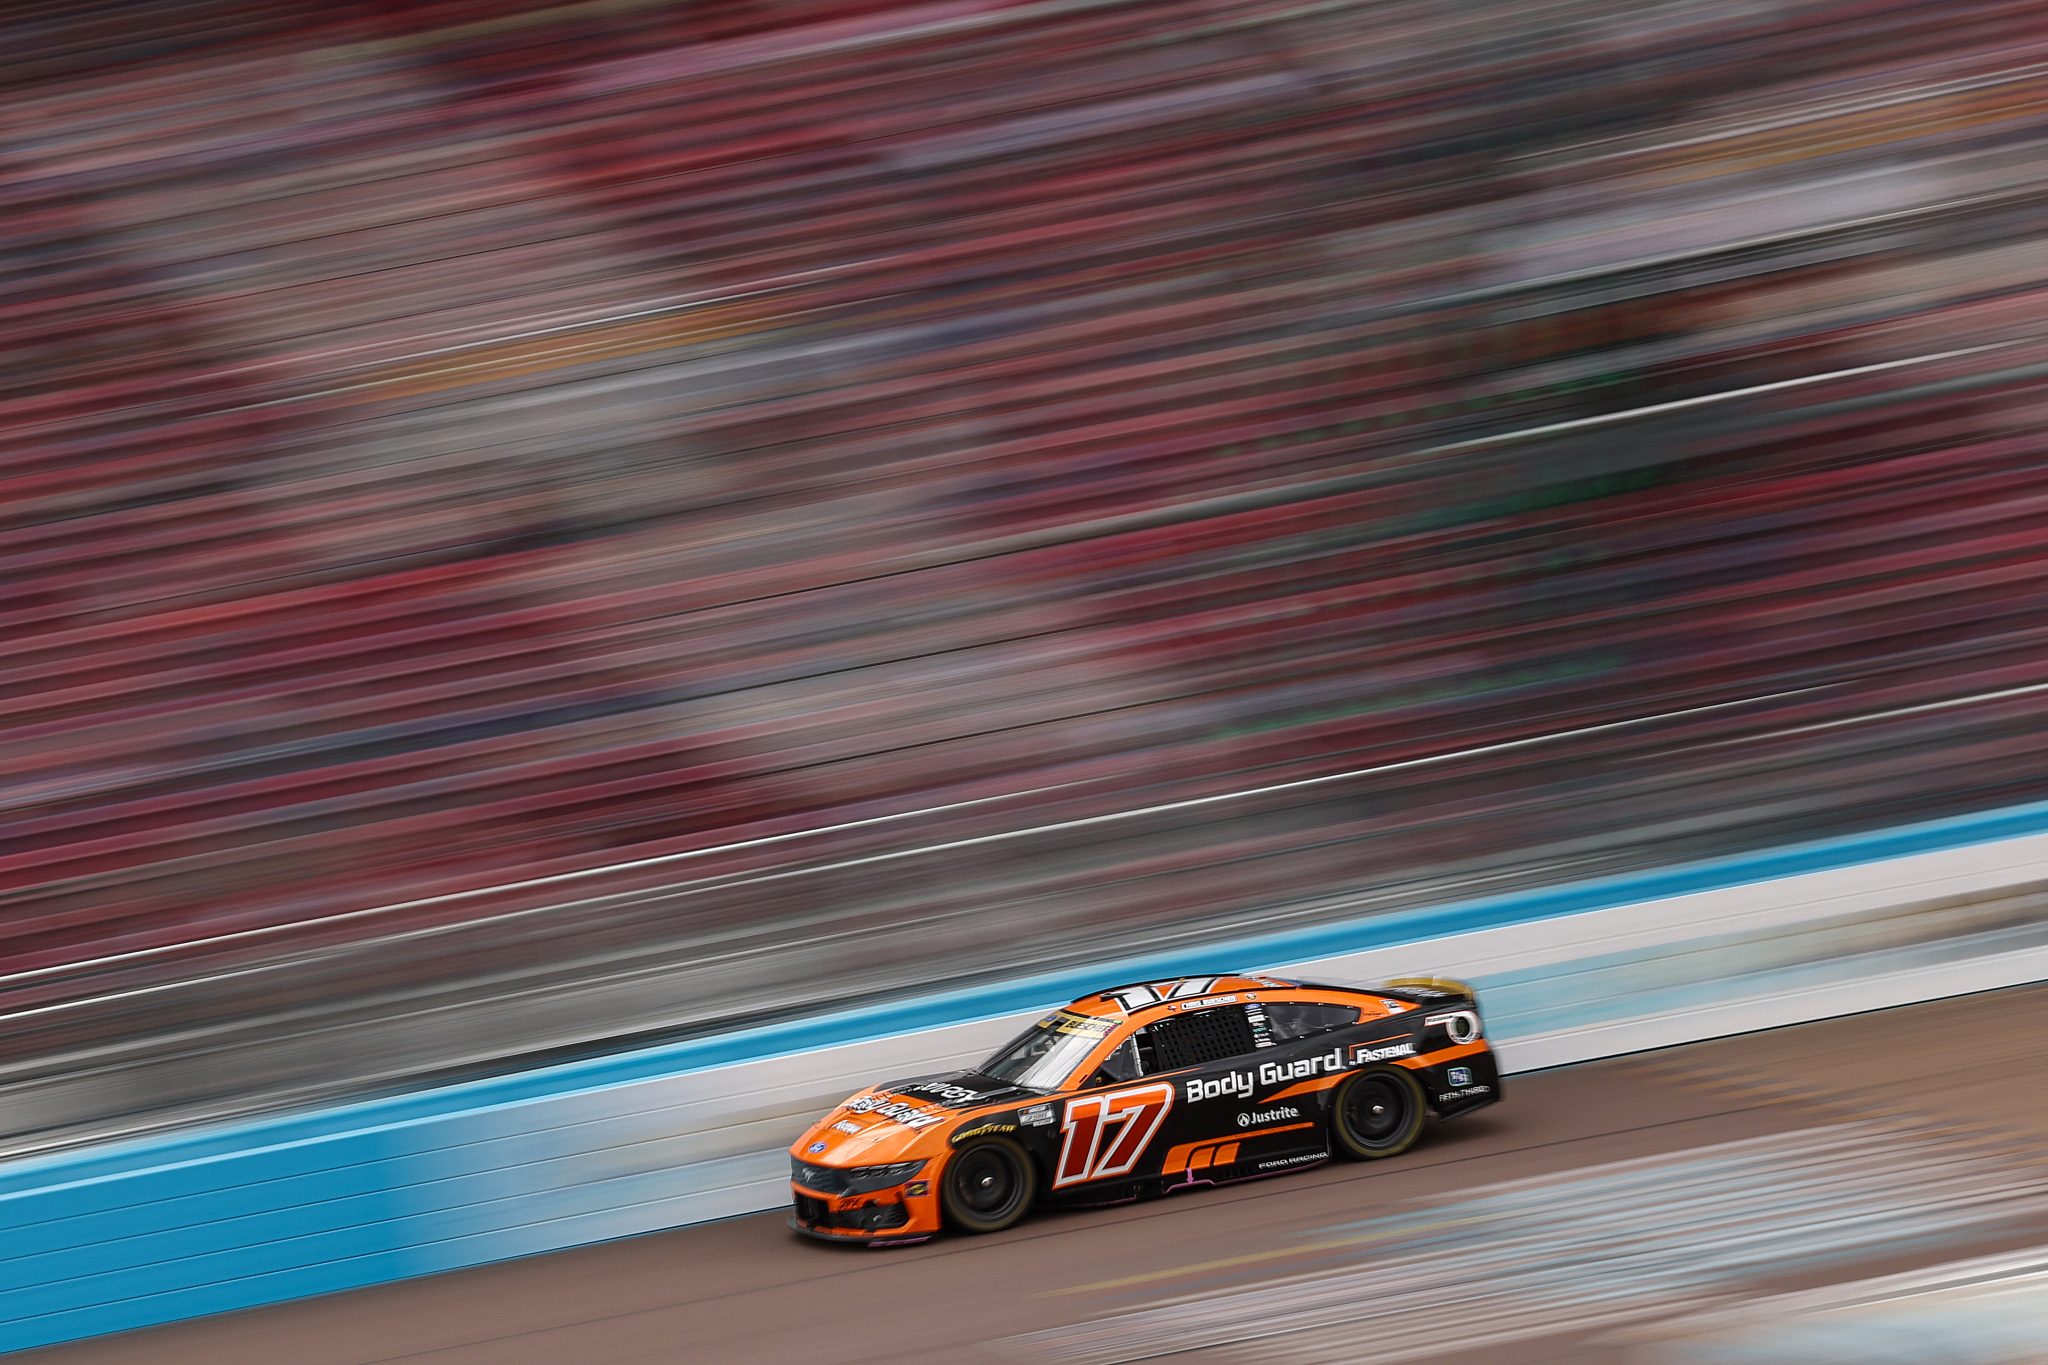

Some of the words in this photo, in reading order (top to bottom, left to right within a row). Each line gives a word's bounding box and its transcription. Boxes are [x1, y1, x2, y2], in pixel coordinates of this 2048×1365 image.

[1103, 976, 1217, 1014] 17
[1182, 1000, 1201, 1010] CHRIS
[1186, 1071, 1254, 1104] Body
[1259, 1048, 1344, 1086] Guard
[1250, 1106, 1299, 1124] Justrite
[951, 1122, 1018, 1144] GOODYEAR
[1053, 1080, 1176, 1191] 17
[1257, 1159, 1288, 1170] FORD
[1288, 1151, 1329, 1164] RACING
